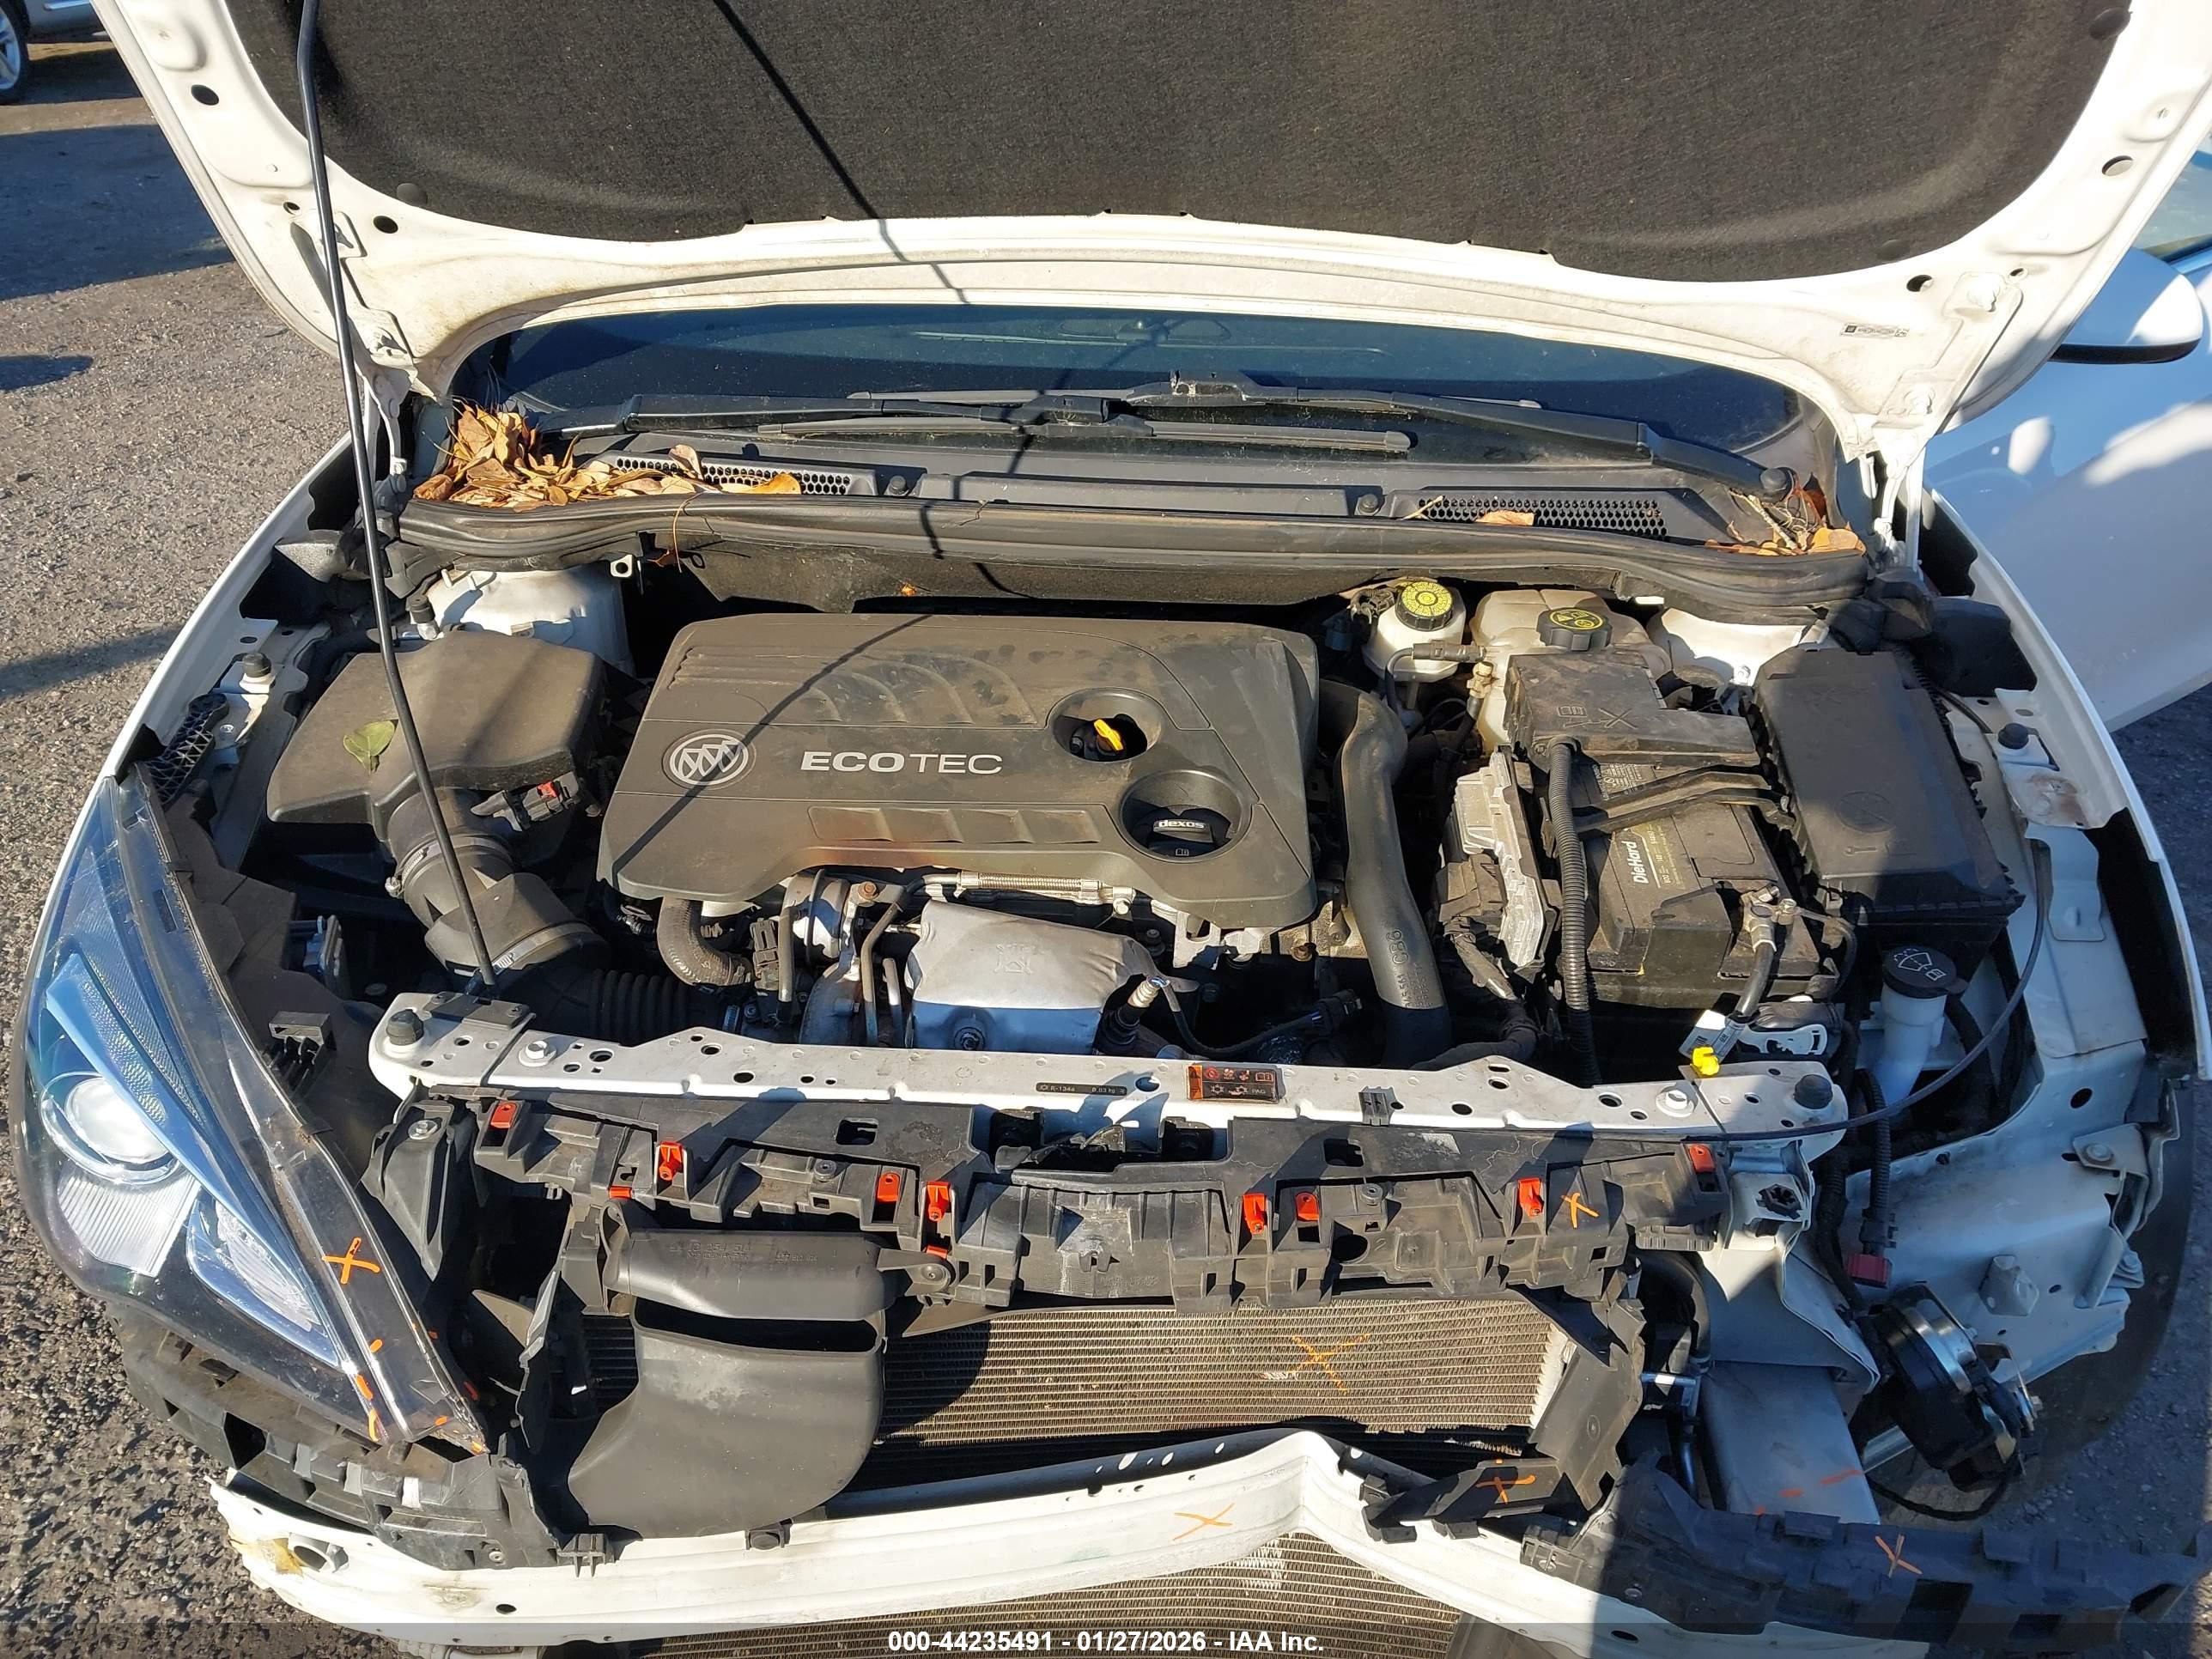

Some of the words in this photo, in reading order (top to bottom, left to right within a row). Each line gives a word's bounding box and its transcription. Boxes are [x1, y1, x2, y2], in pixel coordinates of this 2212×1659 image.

[800, 750, 1003, 775] ECOTEC
[1158, 819, 1206, 829] dexos
[1621, 840, 1650, 884] DieHard
